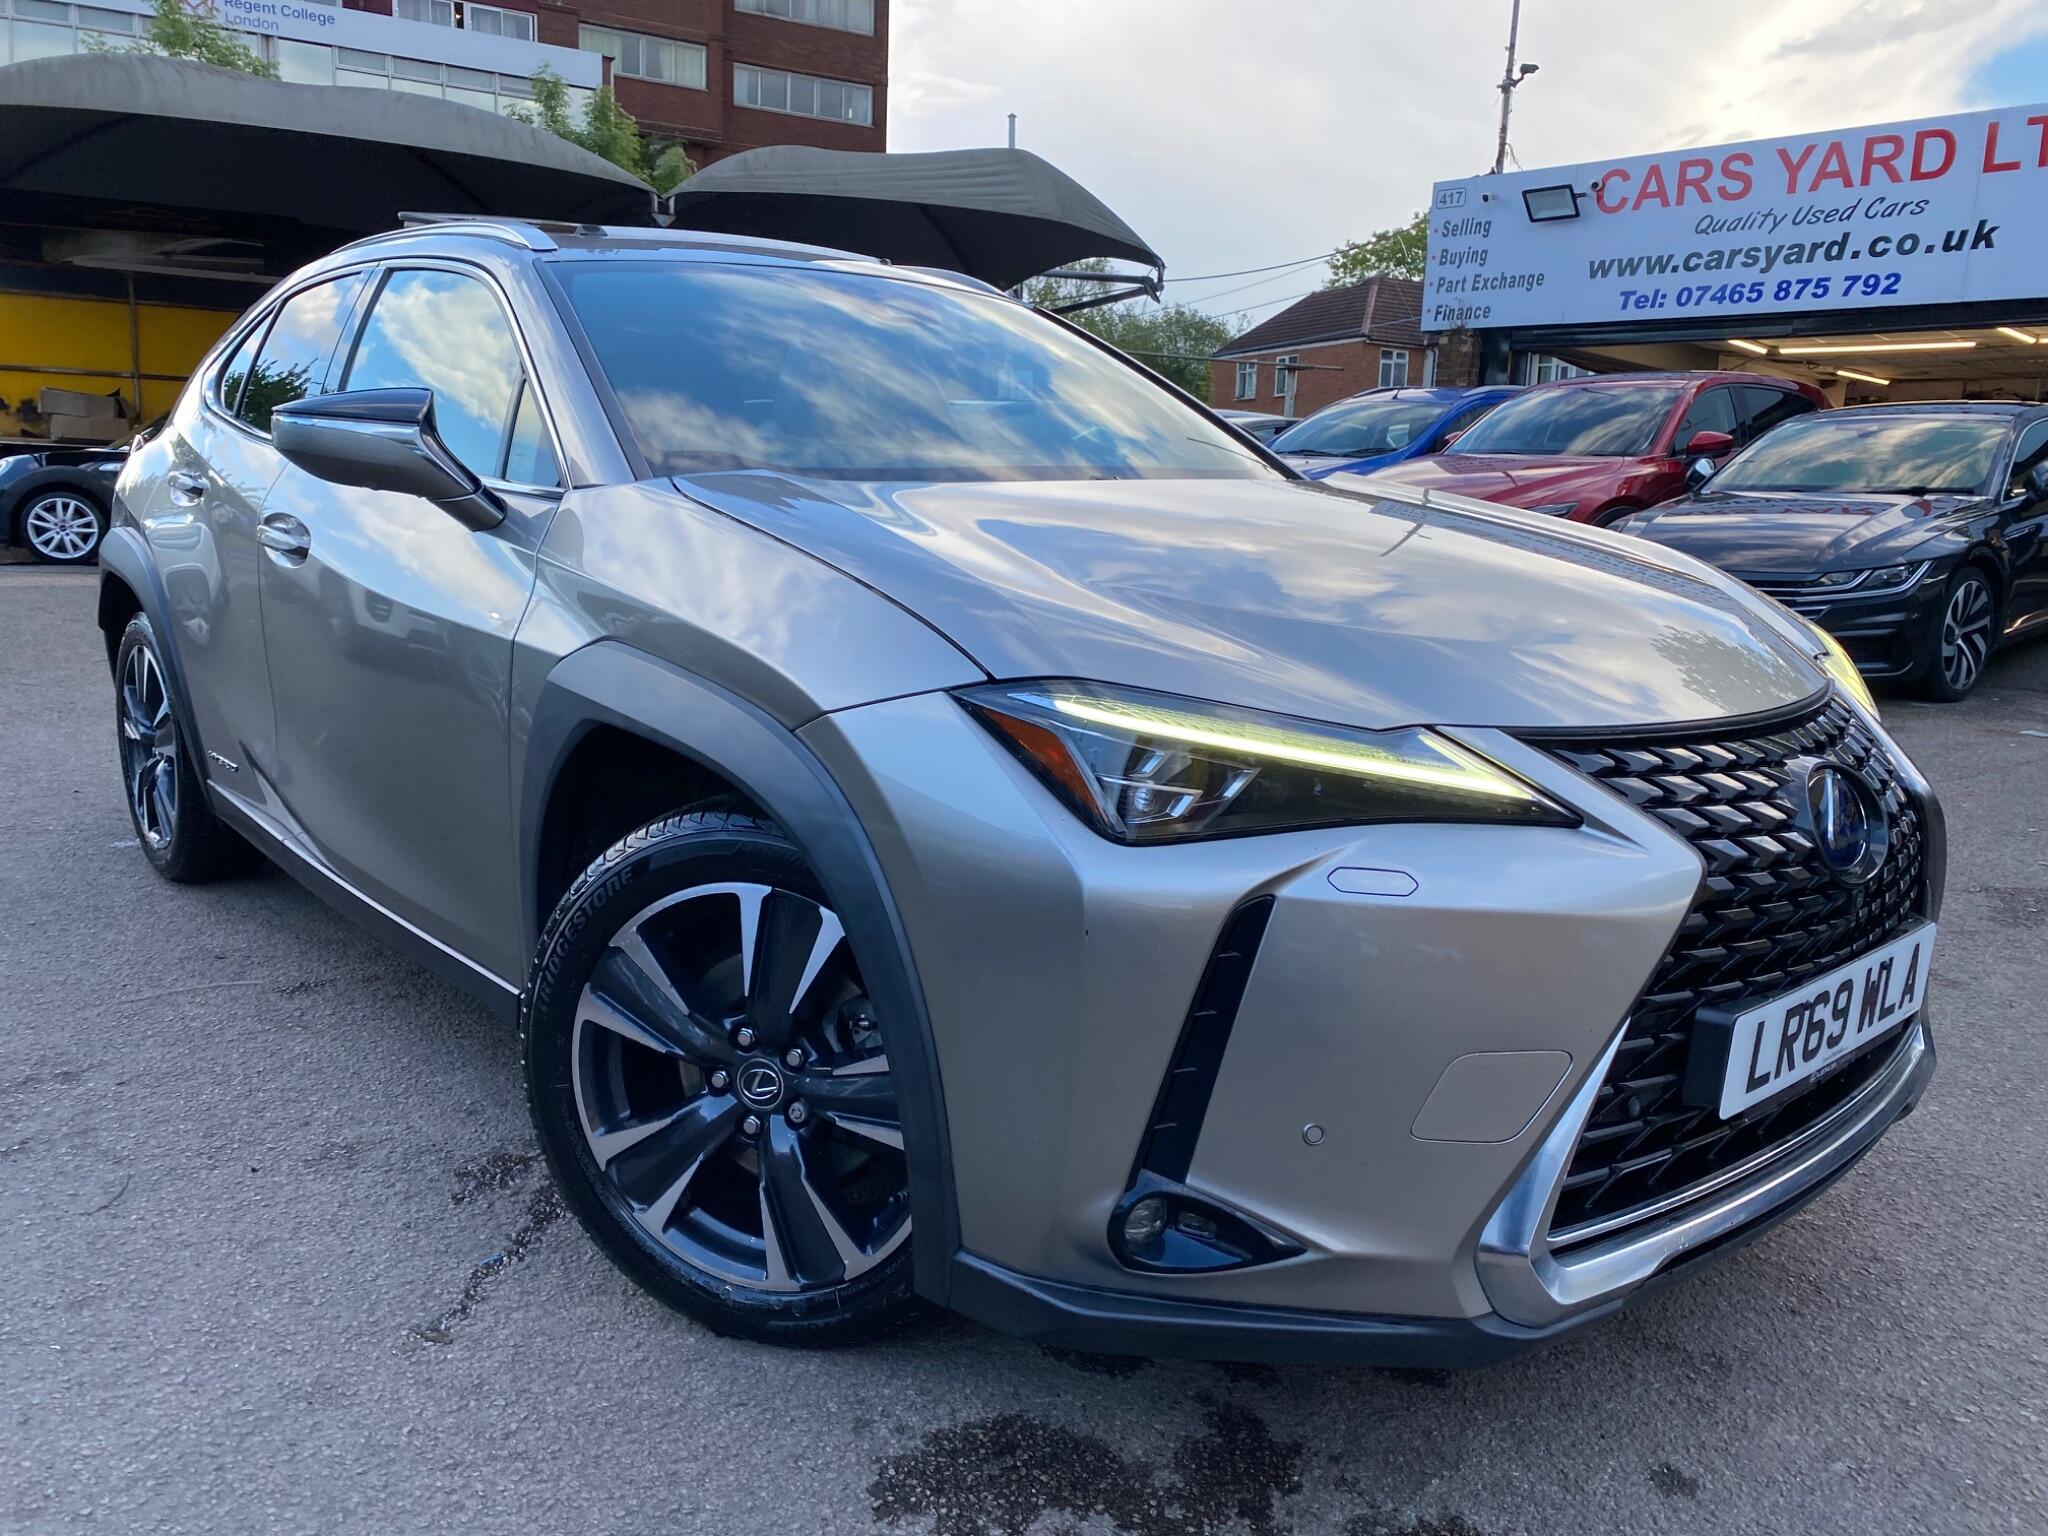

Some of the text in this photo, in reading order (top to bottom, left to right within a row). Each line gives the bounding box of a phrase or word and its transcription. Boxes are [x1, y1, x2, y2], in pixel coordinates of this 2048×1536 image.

[224, 0, 335, 26] Regent College
[224, 12, 279, 31] London
[1596, 152, 1754, 214] CARS
[1775, 128, 1957, 194] YARD
[1439, 191, 1463, 206] 417
[1441, 217, 1492, 238] Selling
[1694, 196, 1930, 235] Quality Used Cars
[1439, 246, 1489, 269] Buying
[1589, 218, 2000, 279] www.carsyard.co.uk
[1436, 271, 1545, 294] Part Exchange
[1619, 272, 1902, 310] Tel: 07465 875 792
[1433, 304, 1491, 322] Finance
[1745, 943, 1921, 1094] LR69 WLA
